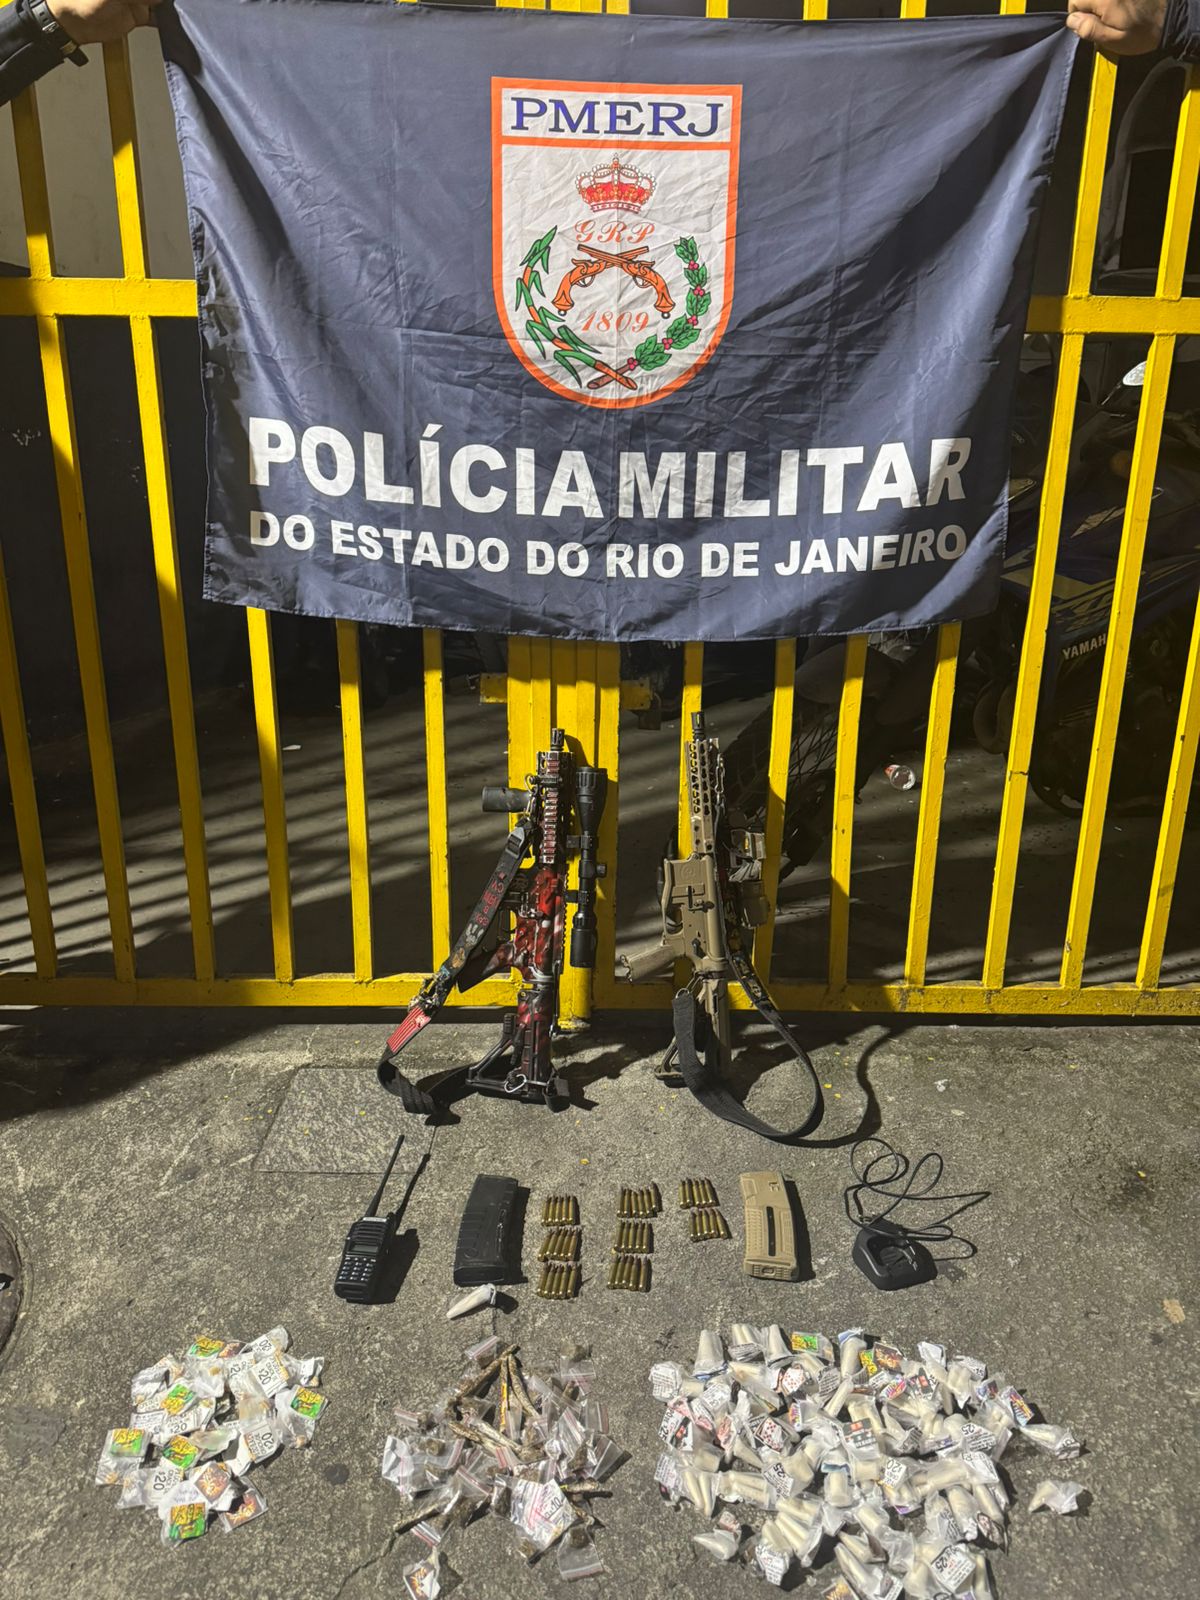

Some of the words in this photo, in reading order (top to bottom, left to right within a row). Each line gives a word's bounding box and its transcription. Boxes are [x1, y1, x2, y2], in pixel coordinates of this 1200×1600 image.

[511, 97, 723, 137] PMERJ
[574, 220, 656, 243] GRP
[581, 310, 649, 332] 1809
[249, 417, 604, 519] POLÍCIA
[618, 437, 972, 519] MILITAR
[250, 511, 315, 551] DO
[330, 519, 510, 573] ESTADO
[526, 540, 589, 577] DO
[606, 543, 685, 578] RIO
[700, 542, 760, 578] DE
[774, 525, 968, 575] JANEIRO
